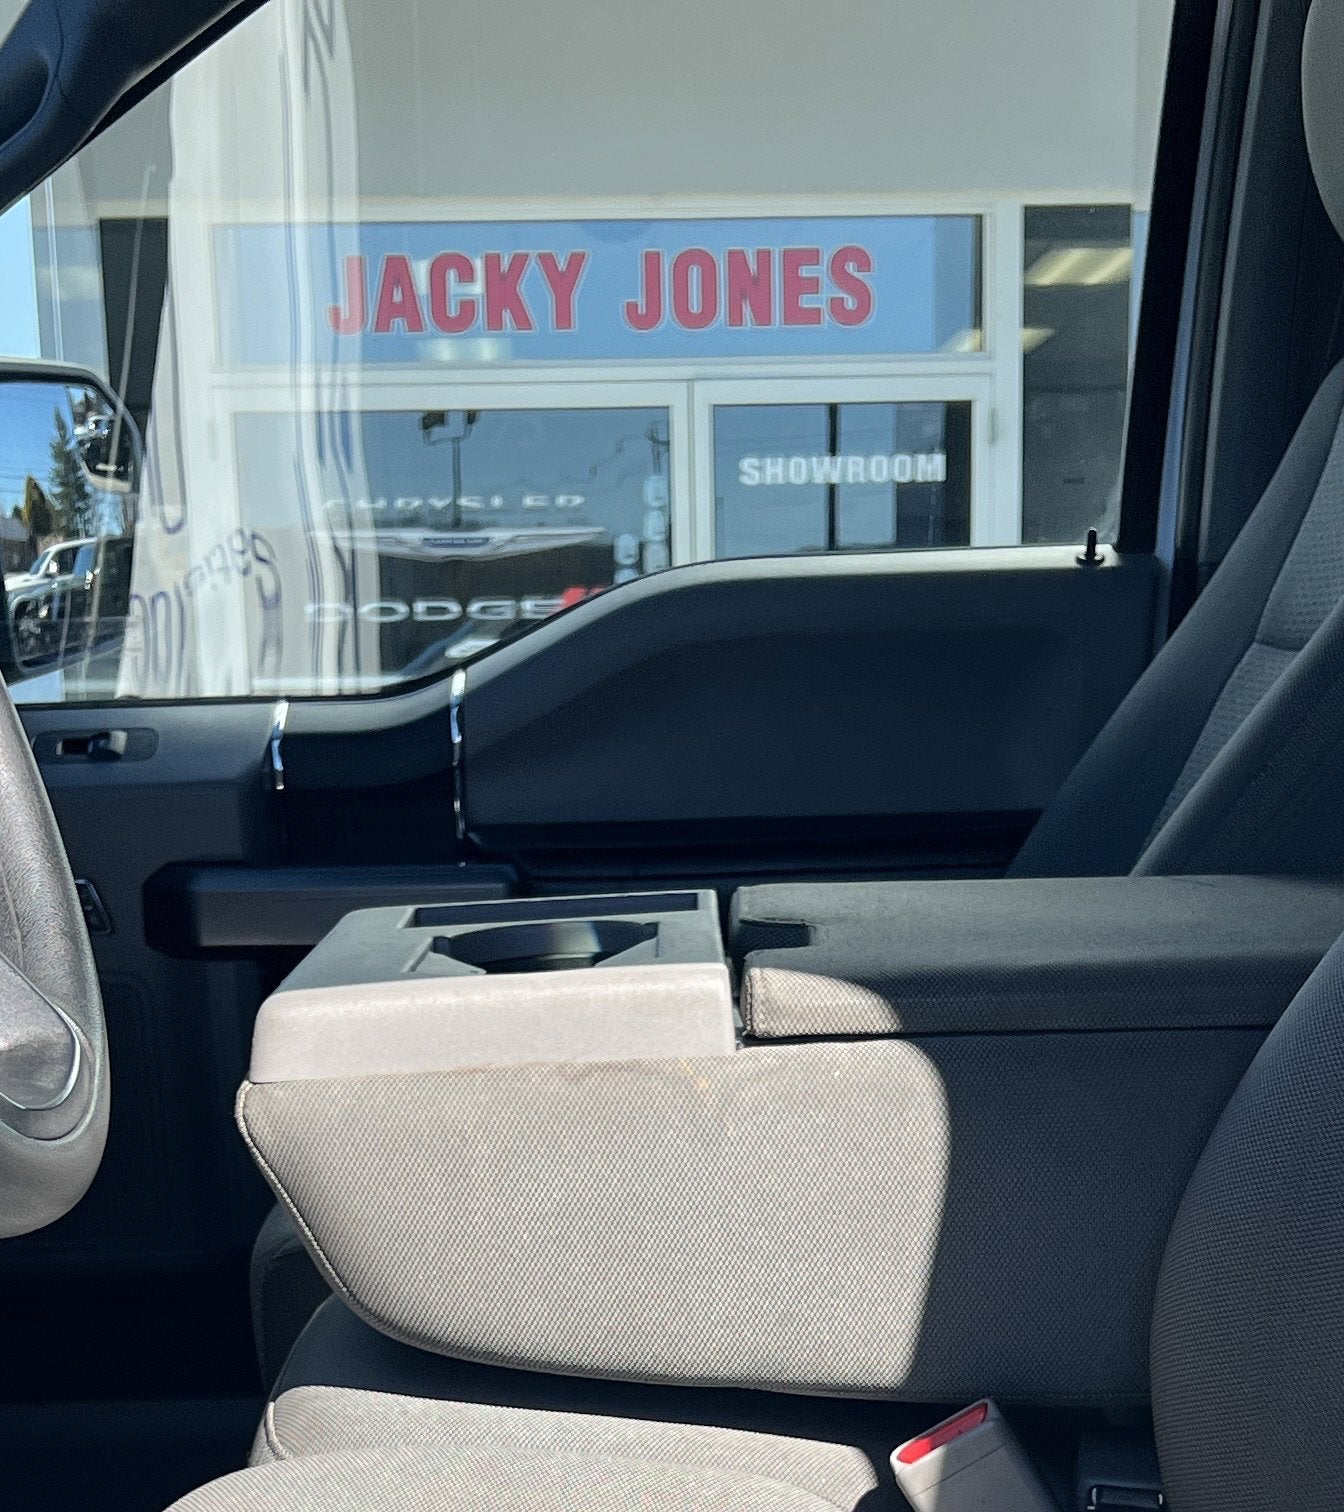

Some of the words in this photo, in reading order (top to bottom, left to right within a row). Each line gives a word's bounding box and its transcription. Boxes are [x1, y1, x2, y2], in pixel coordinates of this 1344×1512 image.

[325, 250, 589, 336] JACKY
[623, 244, 877, 332] JONES
[737, 453, 948, 486] SHOWROOM
[304, 599, 562, 625] DODGE
